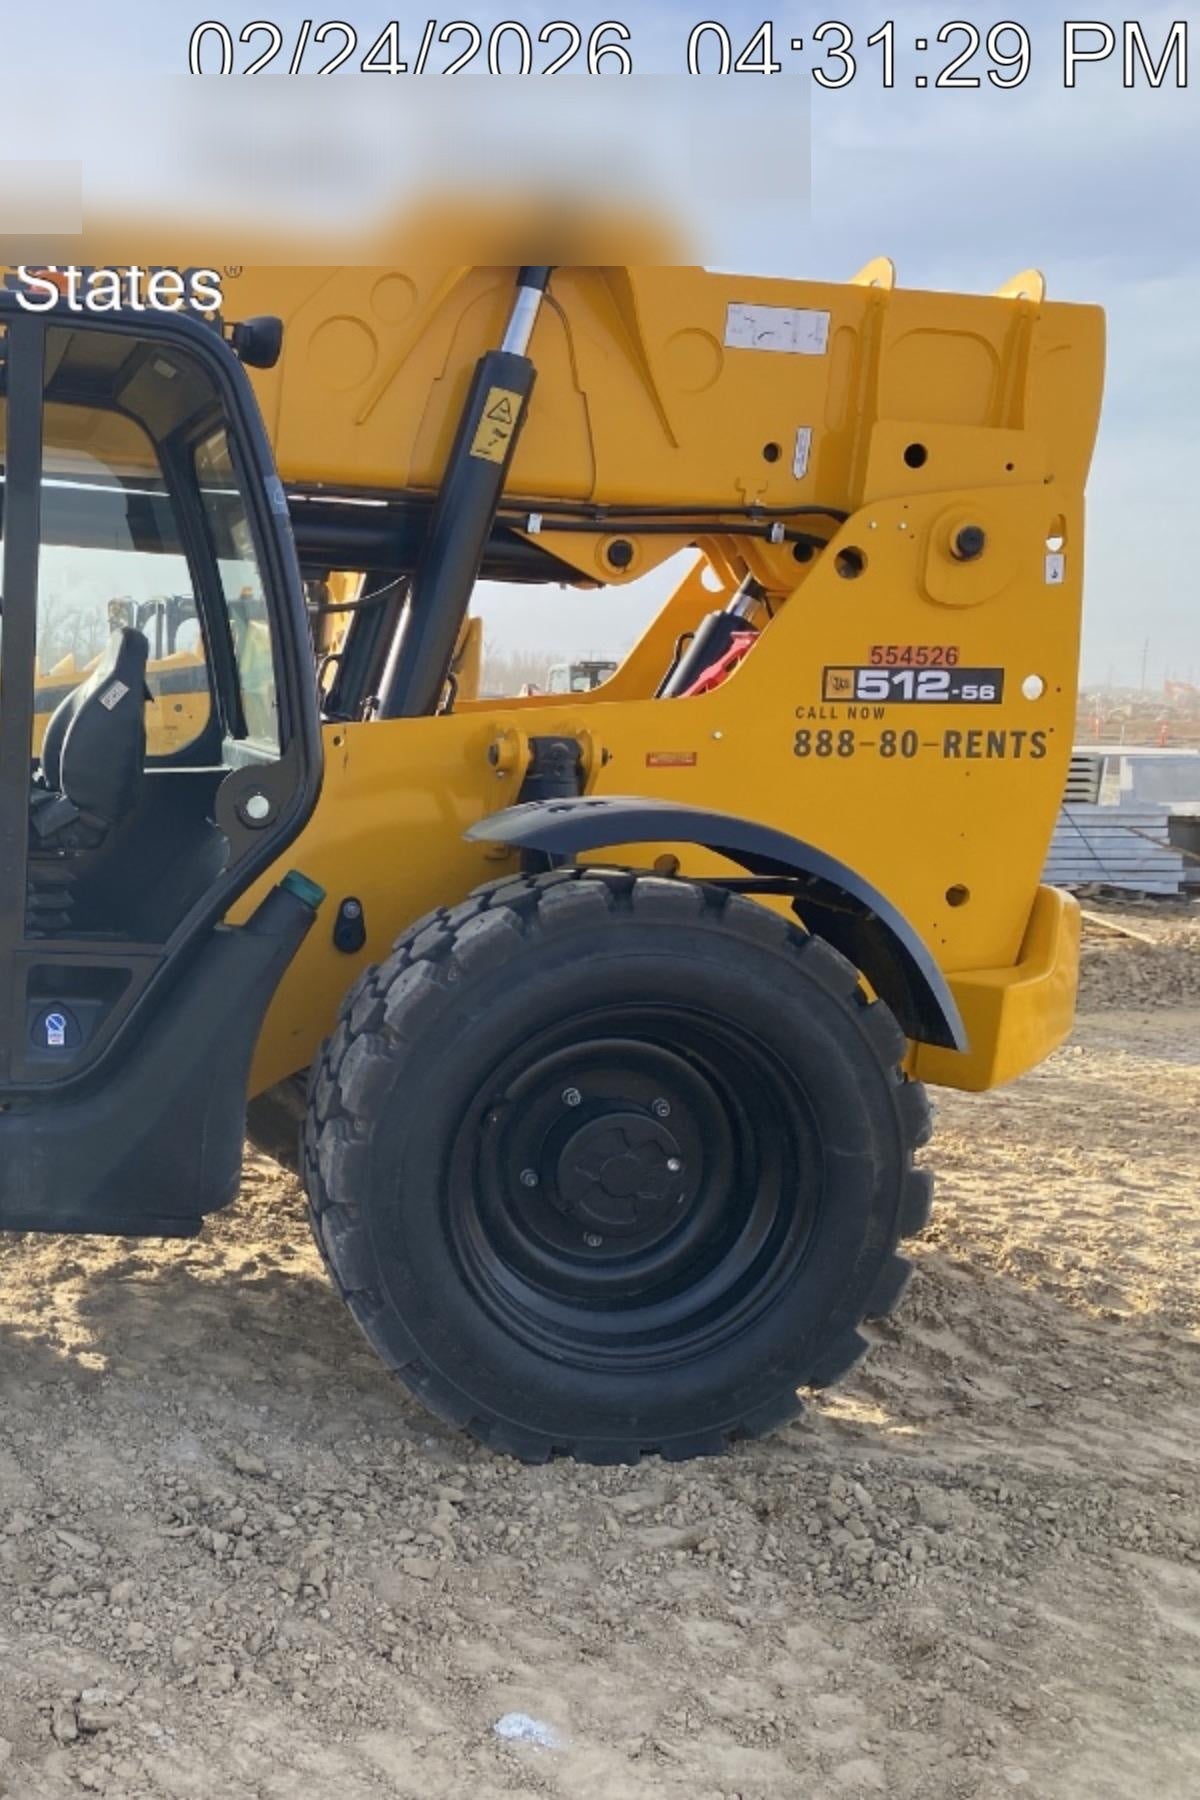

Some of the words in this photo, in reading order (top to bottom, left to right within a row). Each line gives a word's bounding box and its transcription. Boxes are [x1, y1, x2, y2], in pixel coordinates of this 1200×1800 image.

[870, 645, 959, 666] 554526
[855, 669, 996, 700] 512-56
[794, 706, 839, 719] CALL
[847, 707, 886, 720] NOW
[793, 728, 1048, 759] 888-80-RENTS
